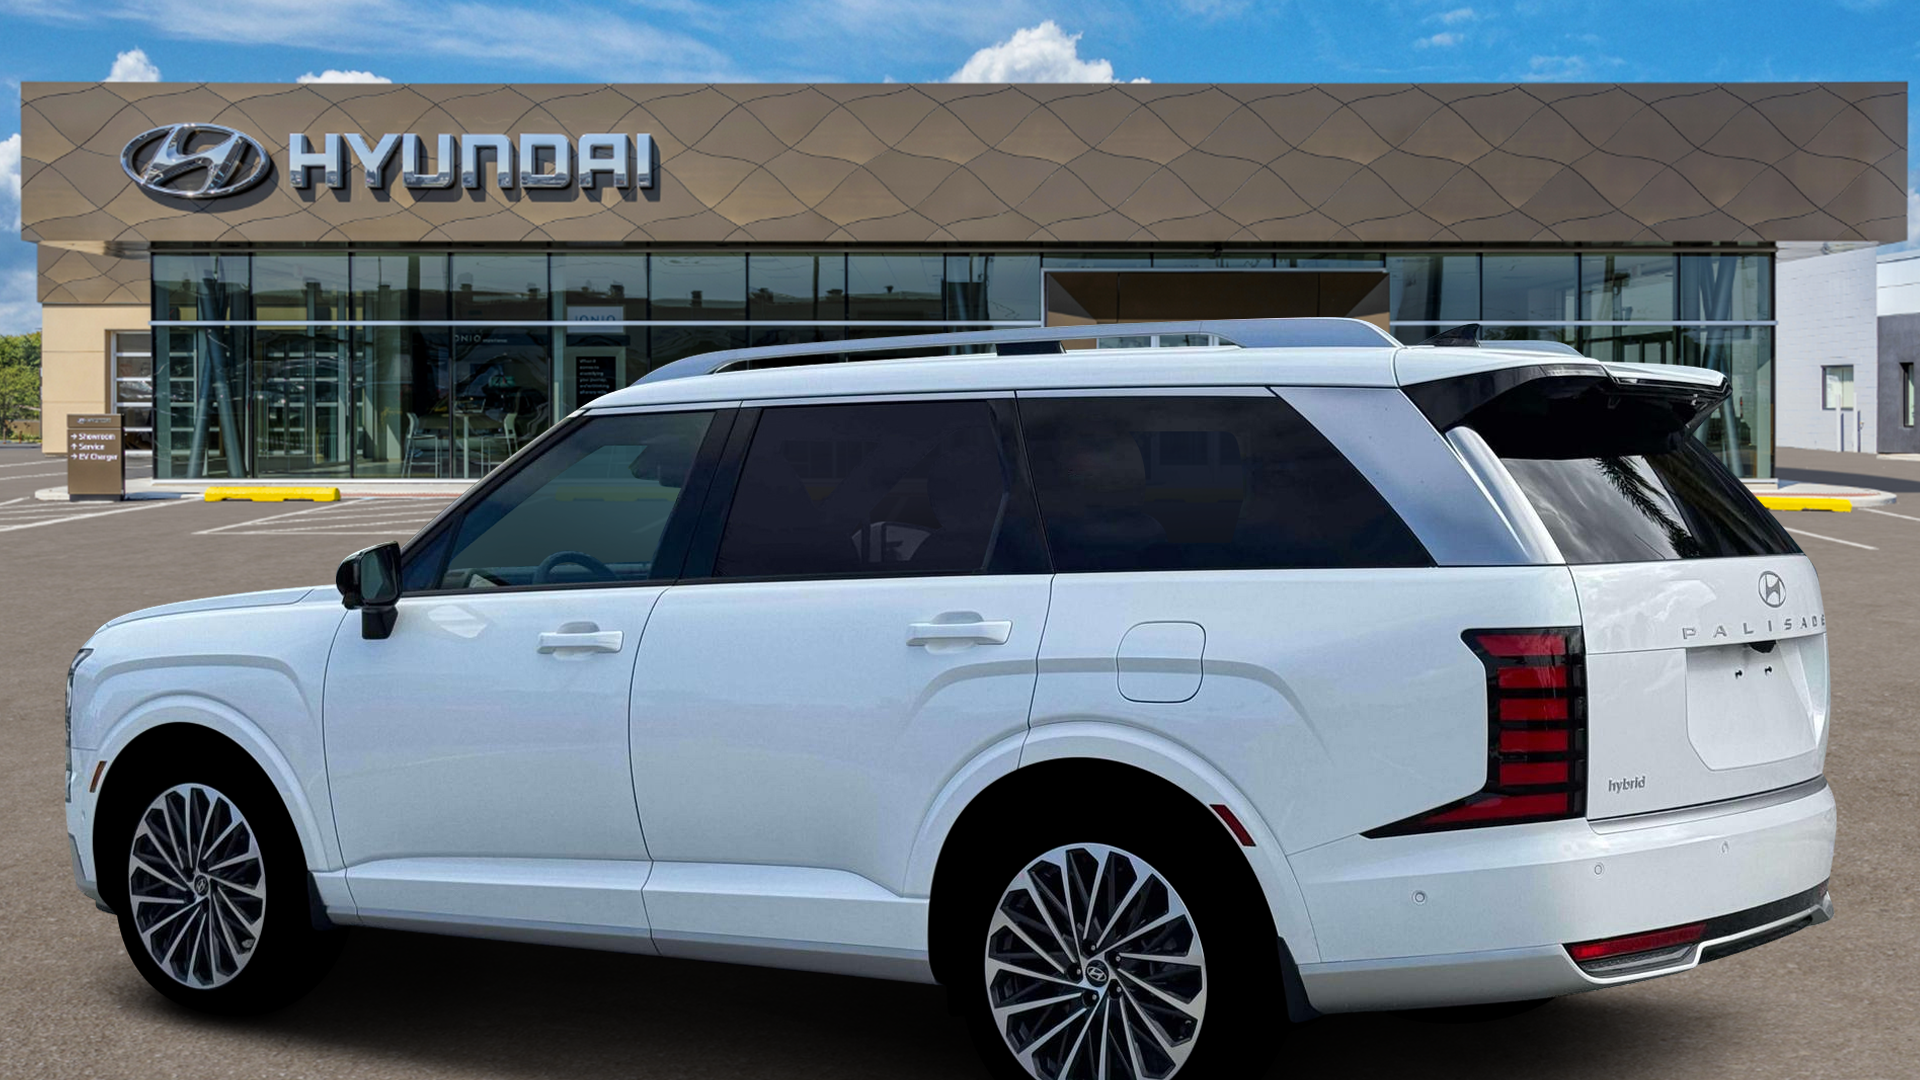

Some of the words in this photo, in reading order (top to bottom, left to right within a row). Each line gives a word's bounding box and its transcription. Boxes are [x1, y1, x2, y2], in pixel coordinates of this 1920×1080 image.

[289, 132, 654, 189] HYUNDAI
[79, 433, 116, 441] Showroom
[79, 443, 105, 451] Service
[90, 453, 118, 462] Charger
[1682, 614, 1826, 639] PALISADE
[1608, 776, 1646, 794] hybrid
